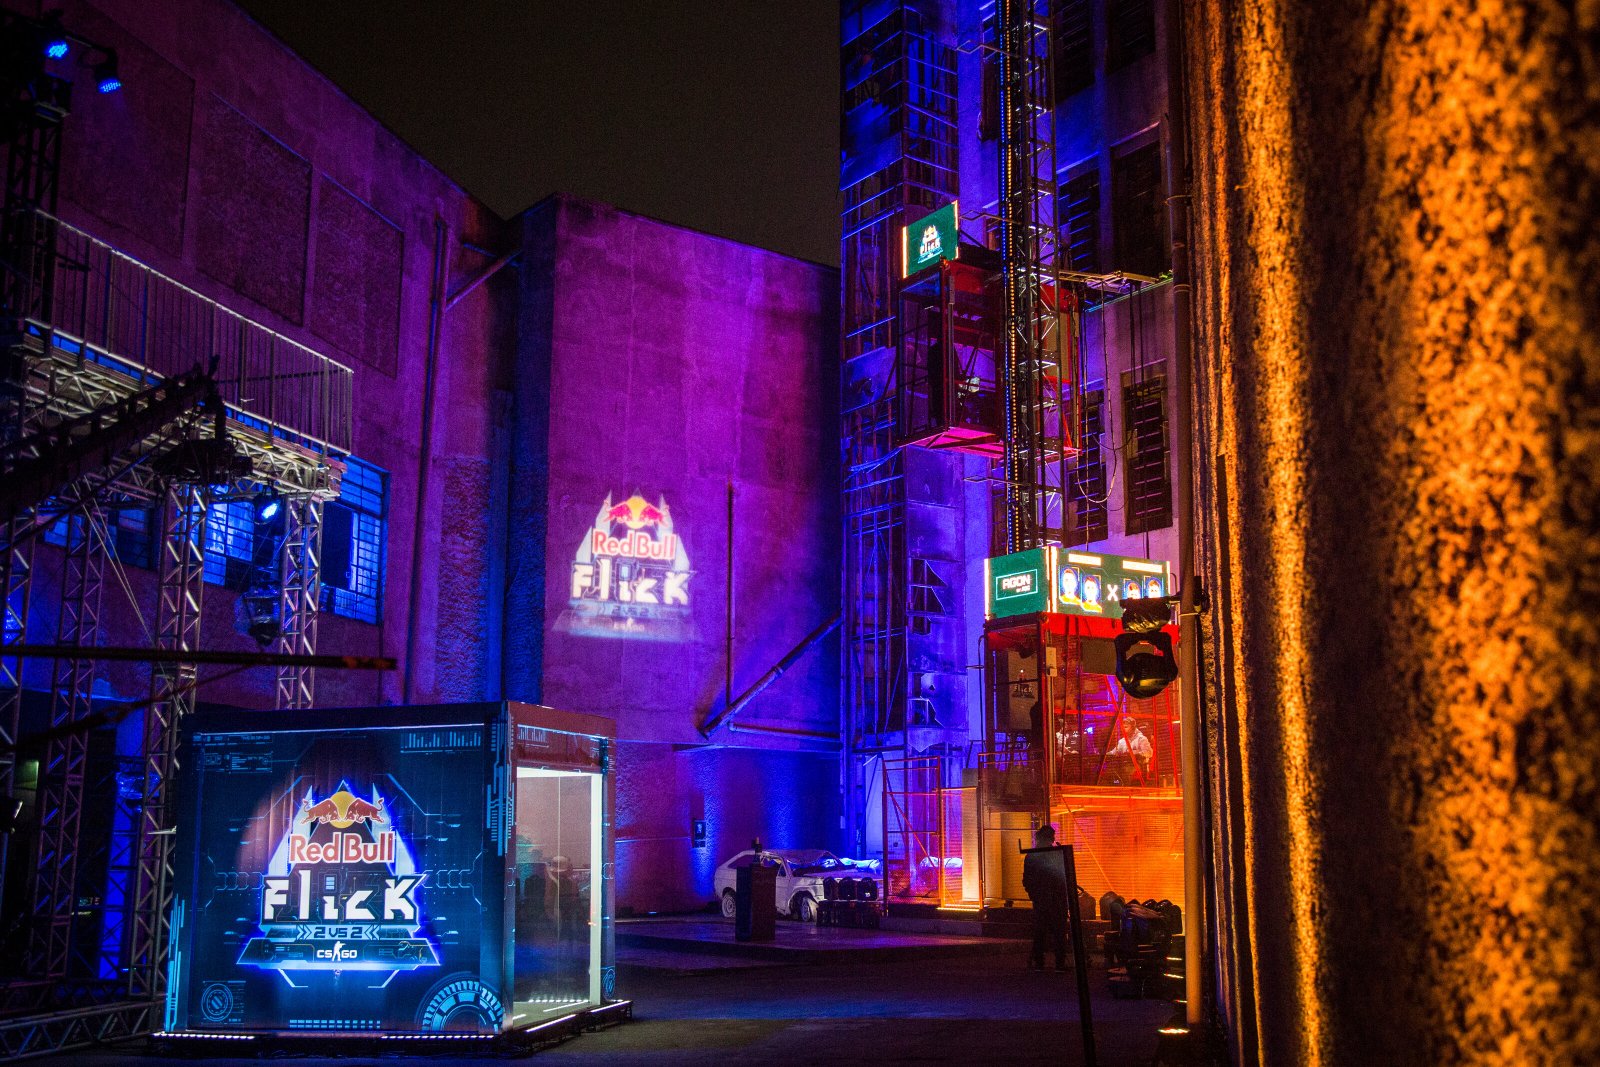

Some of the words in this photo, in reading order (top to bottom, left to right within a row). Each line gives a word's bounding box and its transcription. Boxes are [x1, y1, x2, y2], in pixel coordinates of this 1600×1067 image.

[592, 528, 634, 557] Red
[635, 532, 677, 560] Bull
[289, 832, 341, 864] Red
[343, 831, 395, 863] Bull
[314, 926, 326, 938] 2
[350, 926, 363, 938] 2
